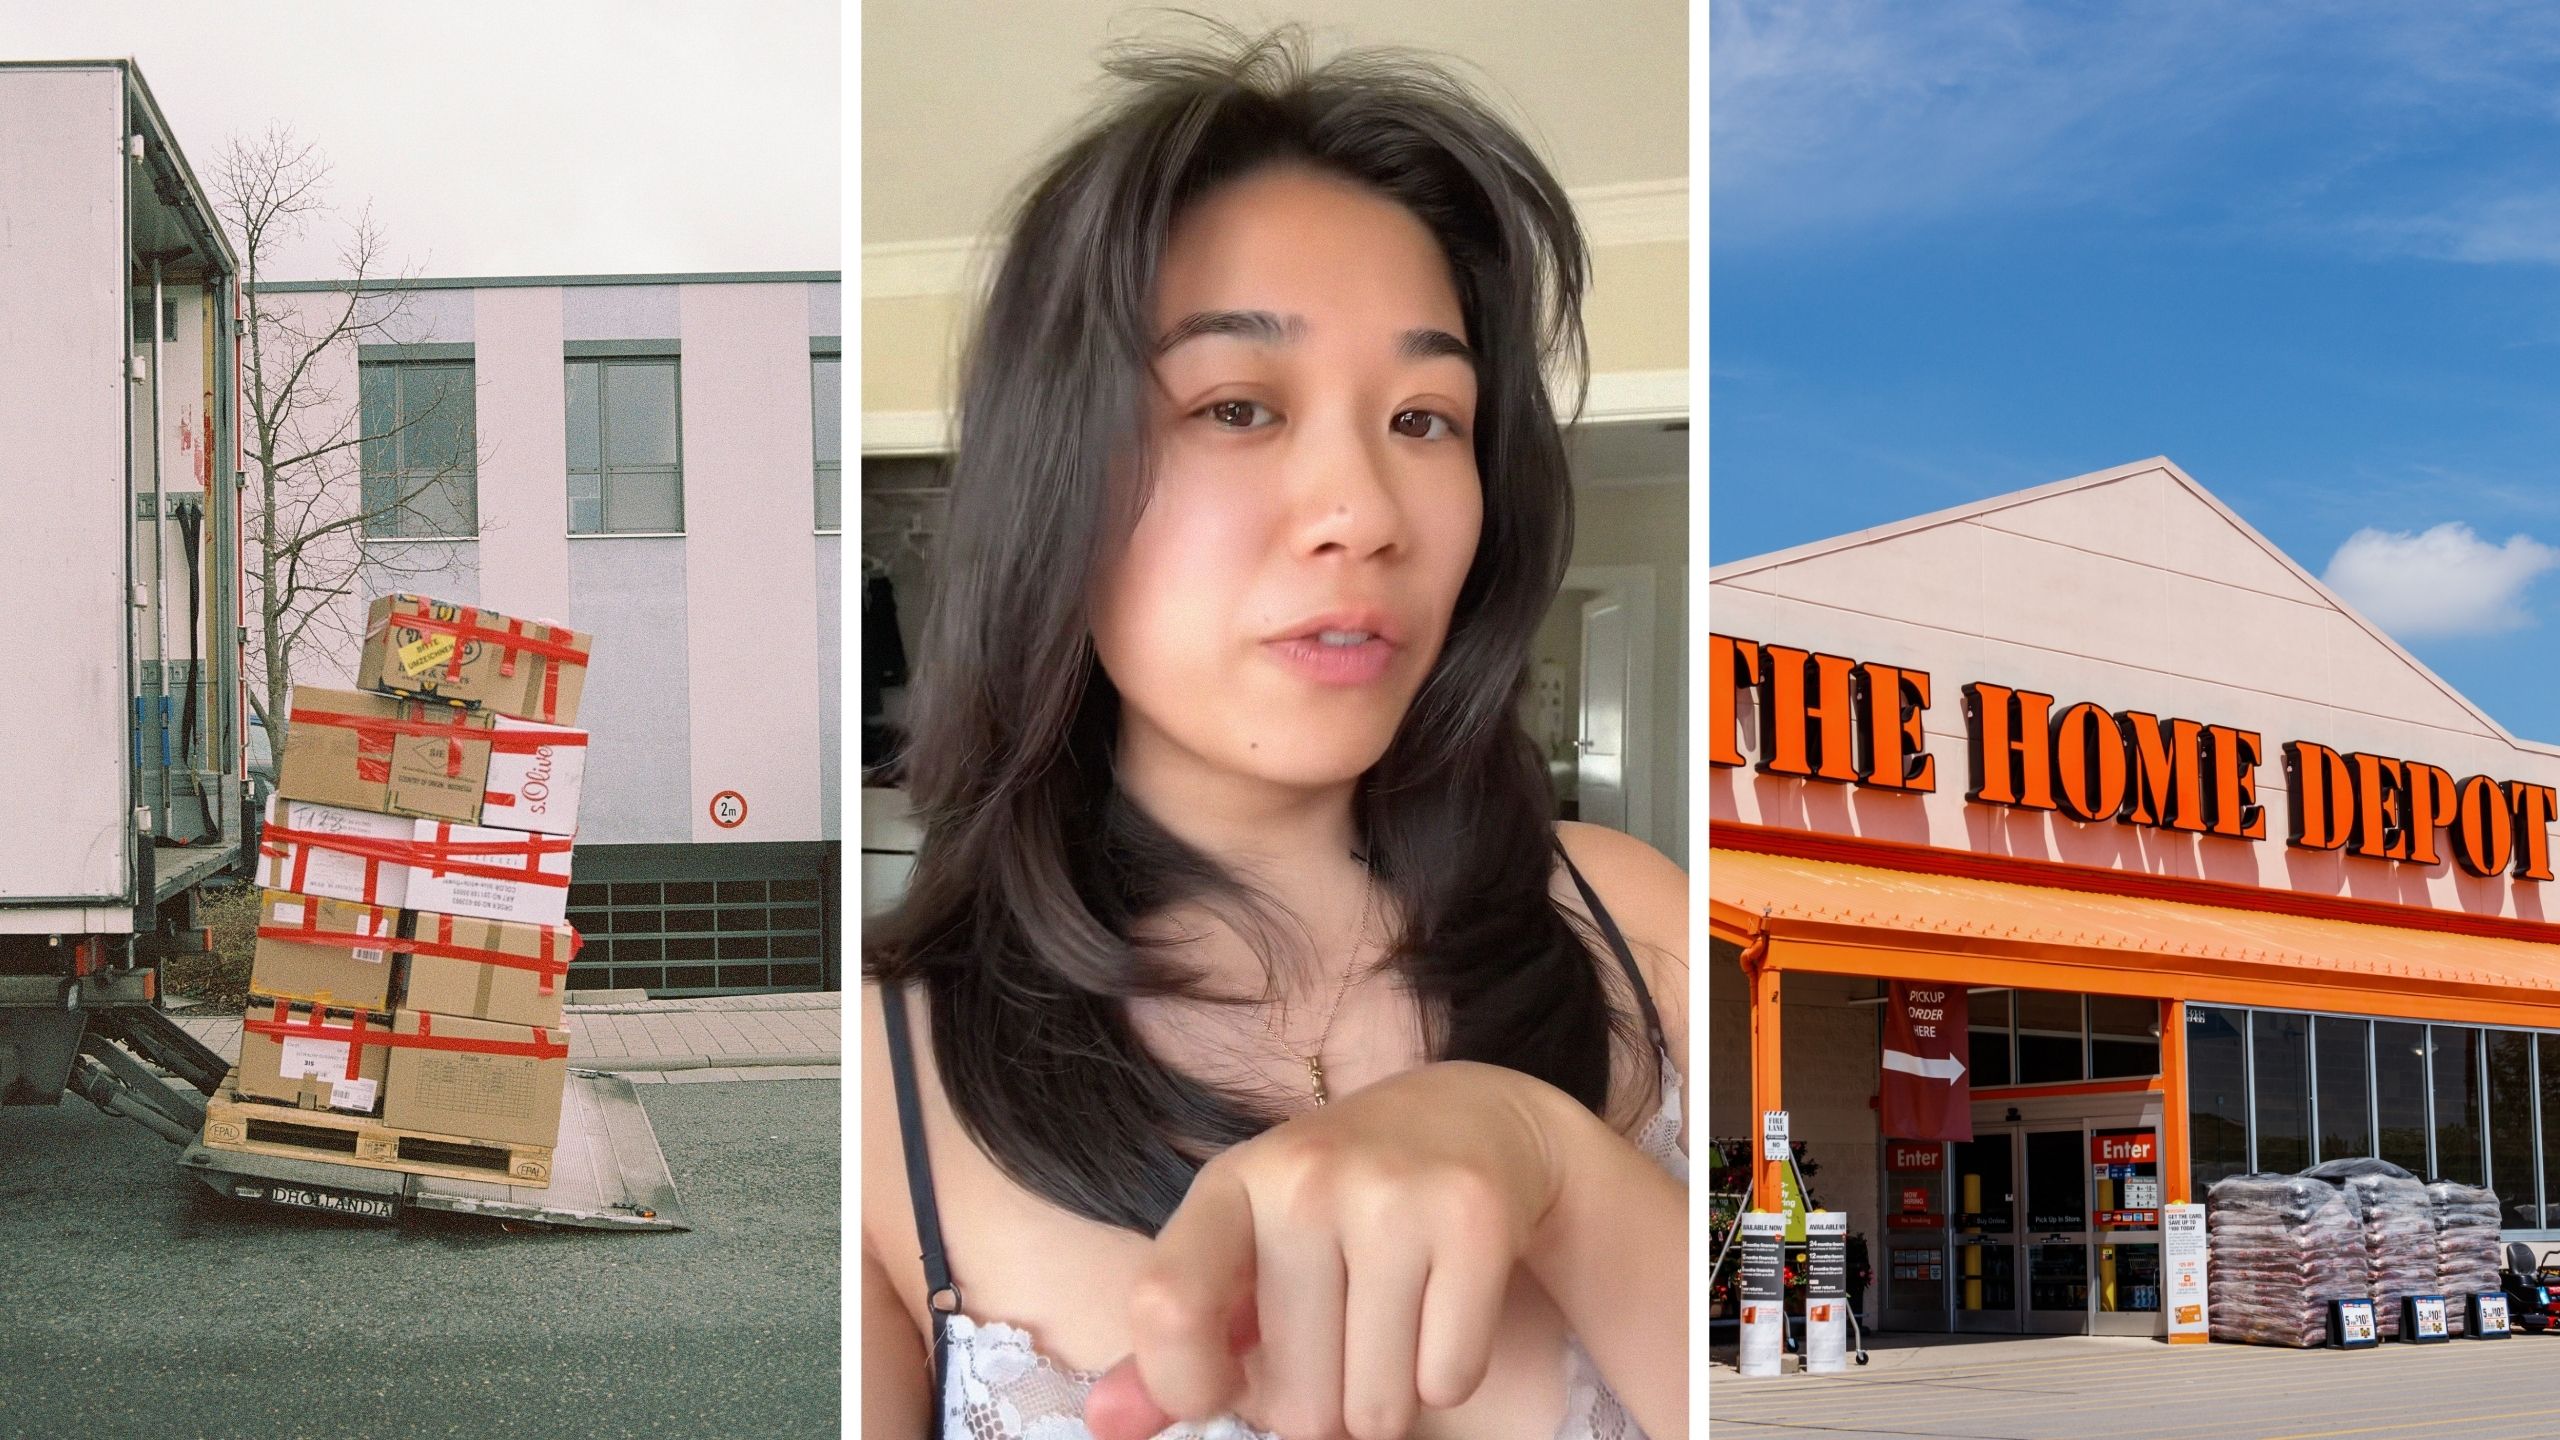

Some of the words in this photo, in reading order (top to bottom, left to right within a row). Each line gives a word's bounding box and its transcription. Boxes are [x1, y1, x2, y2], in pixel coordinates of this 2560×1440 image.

[1709, 632, 1936, 793] THE
[1962, 681, 2266, 841] HOME
[2282, 740, 2558, 882] DEPOT
[522, 745, 553, 814] s.Olive
[1909, 990, 1945, 1003] PICKUP
[1908, 1006, 1944, 1021] ORDER
[1914, 1025, 1936, 1037] HERE
[213, 1127, 234, 1139] EPAL
[1768, 1124, 1784, 1132] LANE
[2103, 1139, 2150, 1159] Enter
[1897, 1149, 1938, 1167] Enter
[272, 1188, 392, 1217] DHOLLANDIA
[2049, 1216, 2057, 1224] Up
[2419, 1311, 2423, 1320] 5
[2483, 1308, 2487, 1318] 5
[2345, 1315, 2350, 1325] 5
